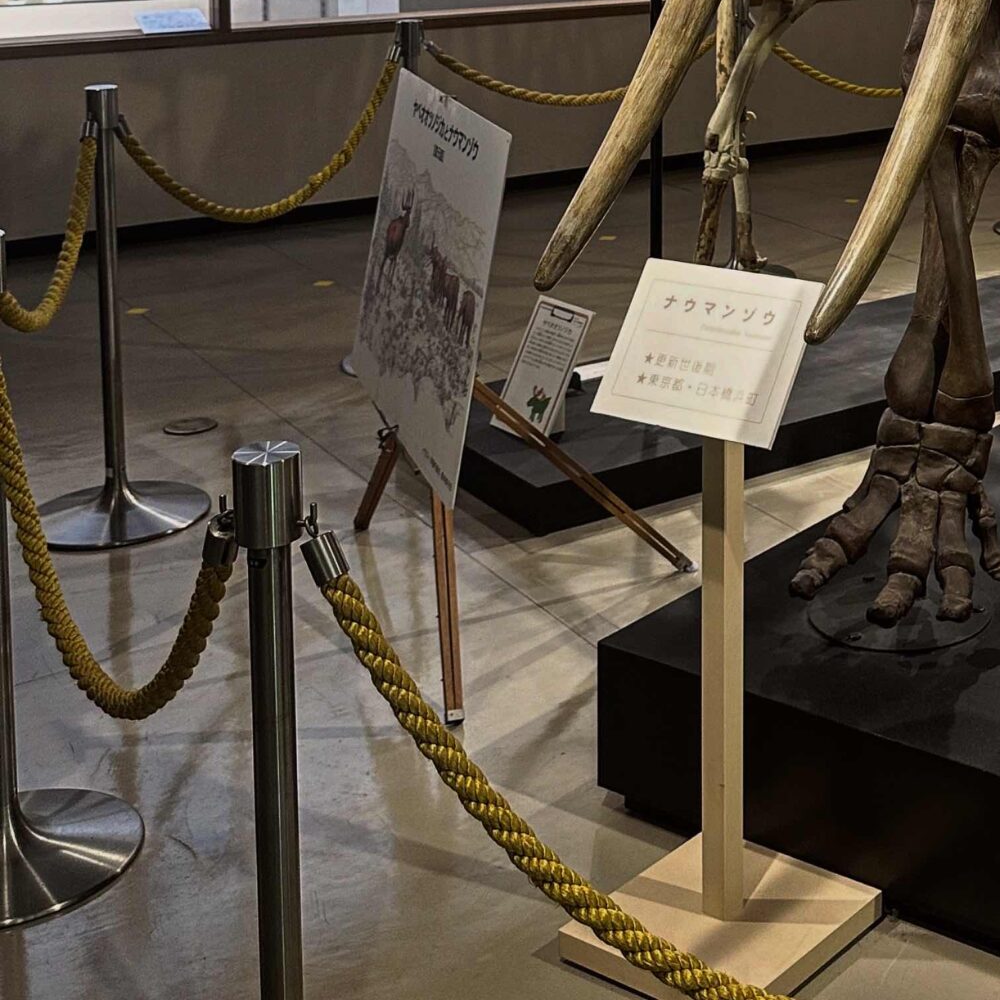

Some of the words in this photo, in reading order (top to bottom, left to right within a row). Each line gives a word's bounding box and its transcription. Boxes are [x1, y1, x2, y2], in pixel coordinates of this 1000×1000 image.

[664, 294, 776, 327] ナウマンゾウ
